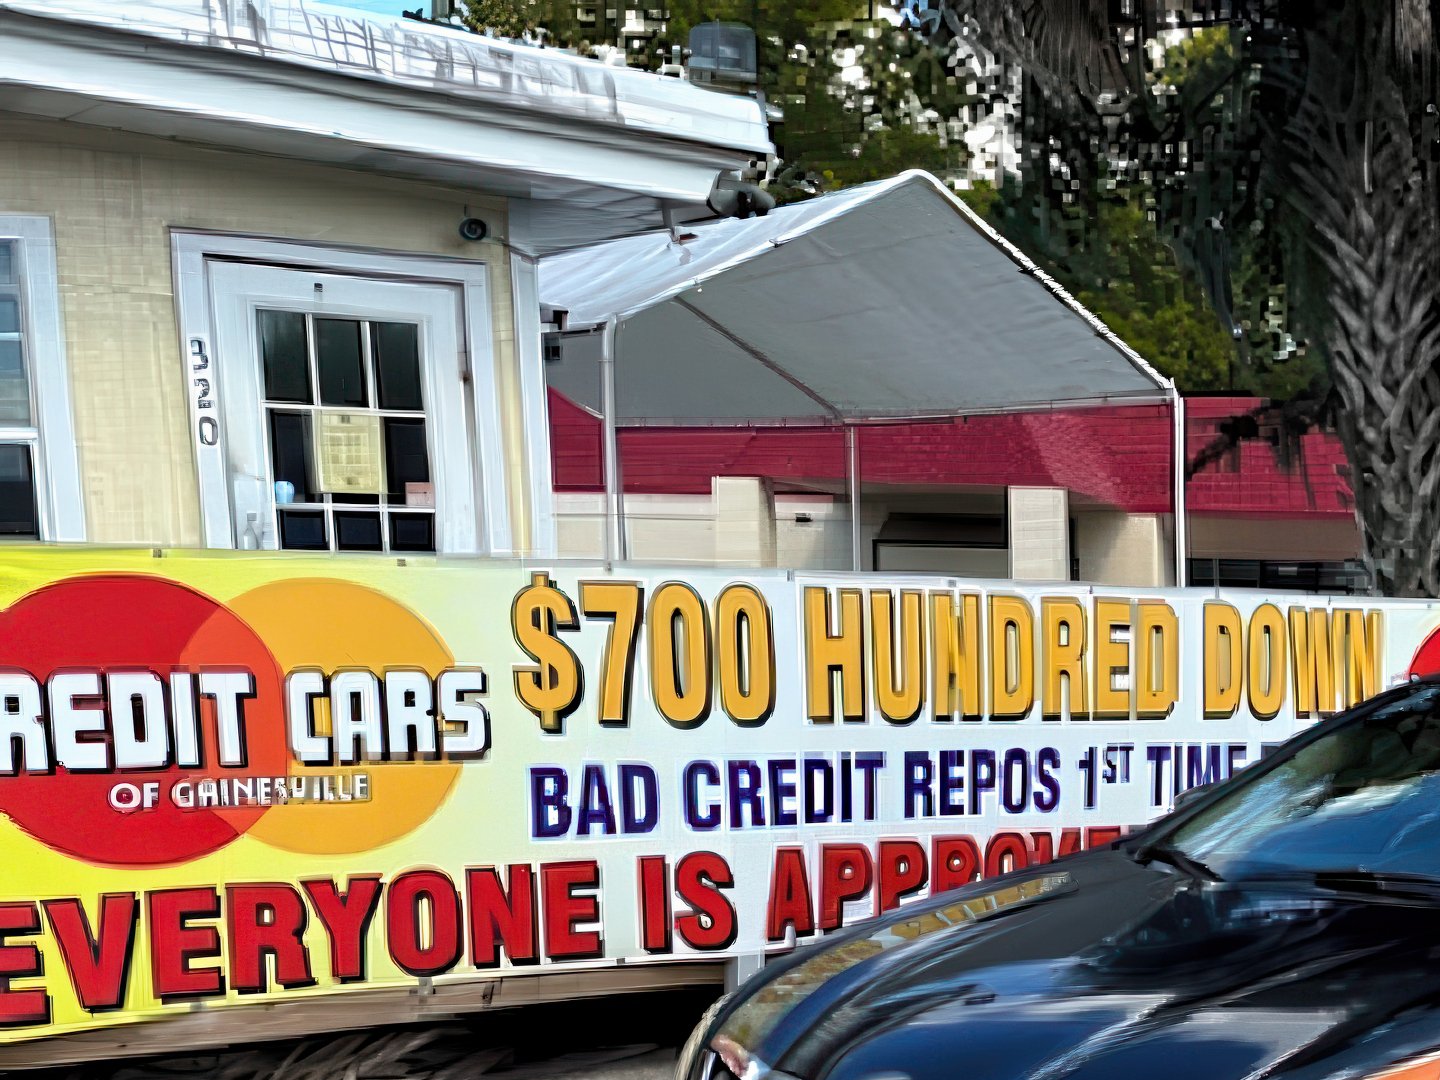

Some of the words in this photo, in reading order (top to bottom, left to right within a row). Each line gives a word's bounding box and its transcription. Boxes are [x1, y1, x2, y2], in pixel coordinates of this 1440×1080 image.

[190, 337, 219, 446] 320
[511, 572, 775, 732] $700
[804, 586, 1179, 725] HUNDRED
[1202, 600, 1385, 721] DOWN
[285, 667, 491, 763] CARS
[108, 782, 160, 813] OF
[530, 764, 660, 837] BAD
[684, 755, 884, 830] CREDIT
[904, 746, 1061, 818] REPOS
[0, 859, 605, 1026] EVERYONE
[636, 851, 739, 953] IS
[766, 826, 1124, 942] APPR
